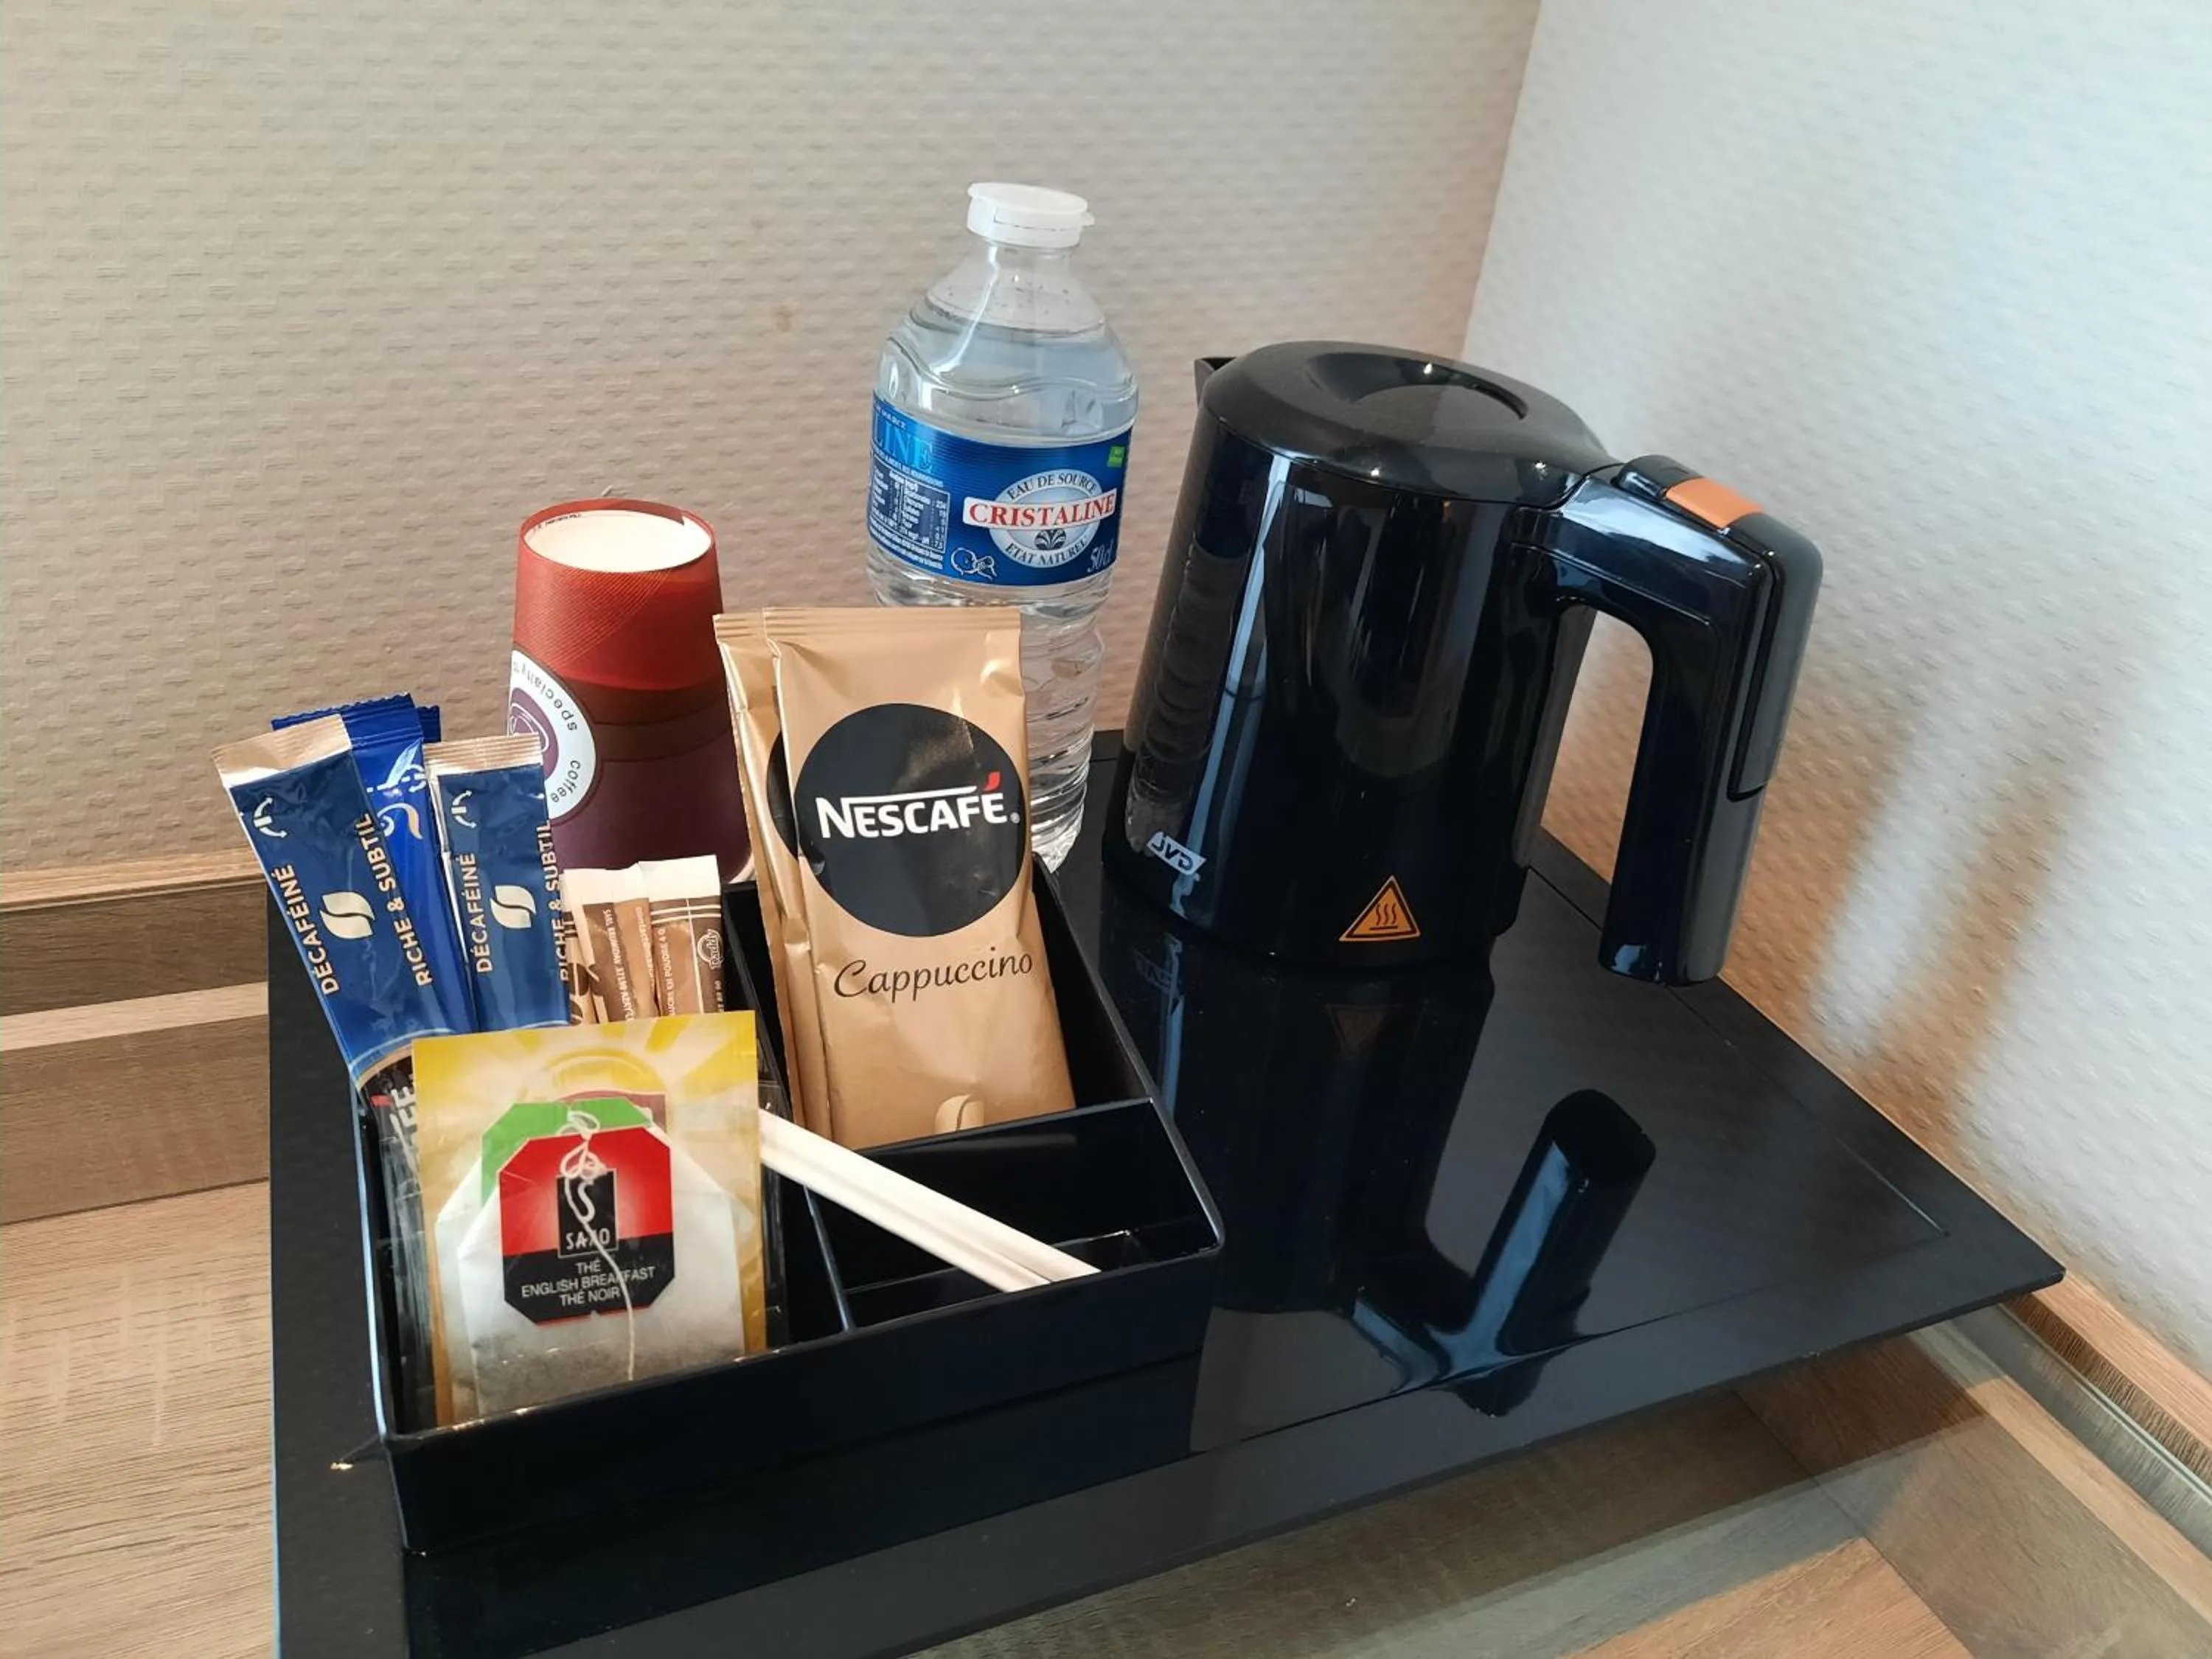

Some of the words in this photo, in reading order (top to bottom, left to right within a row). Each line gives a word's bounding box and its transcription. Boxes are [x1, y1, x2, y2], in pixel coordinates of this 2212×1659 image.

[1007, 482, 1032, 500] EAU
[1037, 474, 1054, 488] DE
[1058, 473, 1097, 495] SOURCE
[970, 493, 1115, 526] CRISTALINE
[1006, 543, 1035, 564] ETAT
[1038, 539, 1088, 565] NATUREL
[550, 759, 581, 804] coffee
[815, 771, 1007, 839] NESCAFÉ
[353, 813, 397, 892] SUBTIL
[536, 819, 560, 892] SUBTIL
[387, 895, 404, 914] &
[455, 852, 493, 973] DÉCAFÉINÉ
[549, 900, 562, 912] &
[271, 863, 340, 995] DÉCAFÉINÉ
[392, 919, 434, 987] RICHE
[834, 947, 1032, 1004] Cappuccino
[521, 1278, 579, 1298] ENGLISH
[588, 1287, 621, 1304] NOIR
